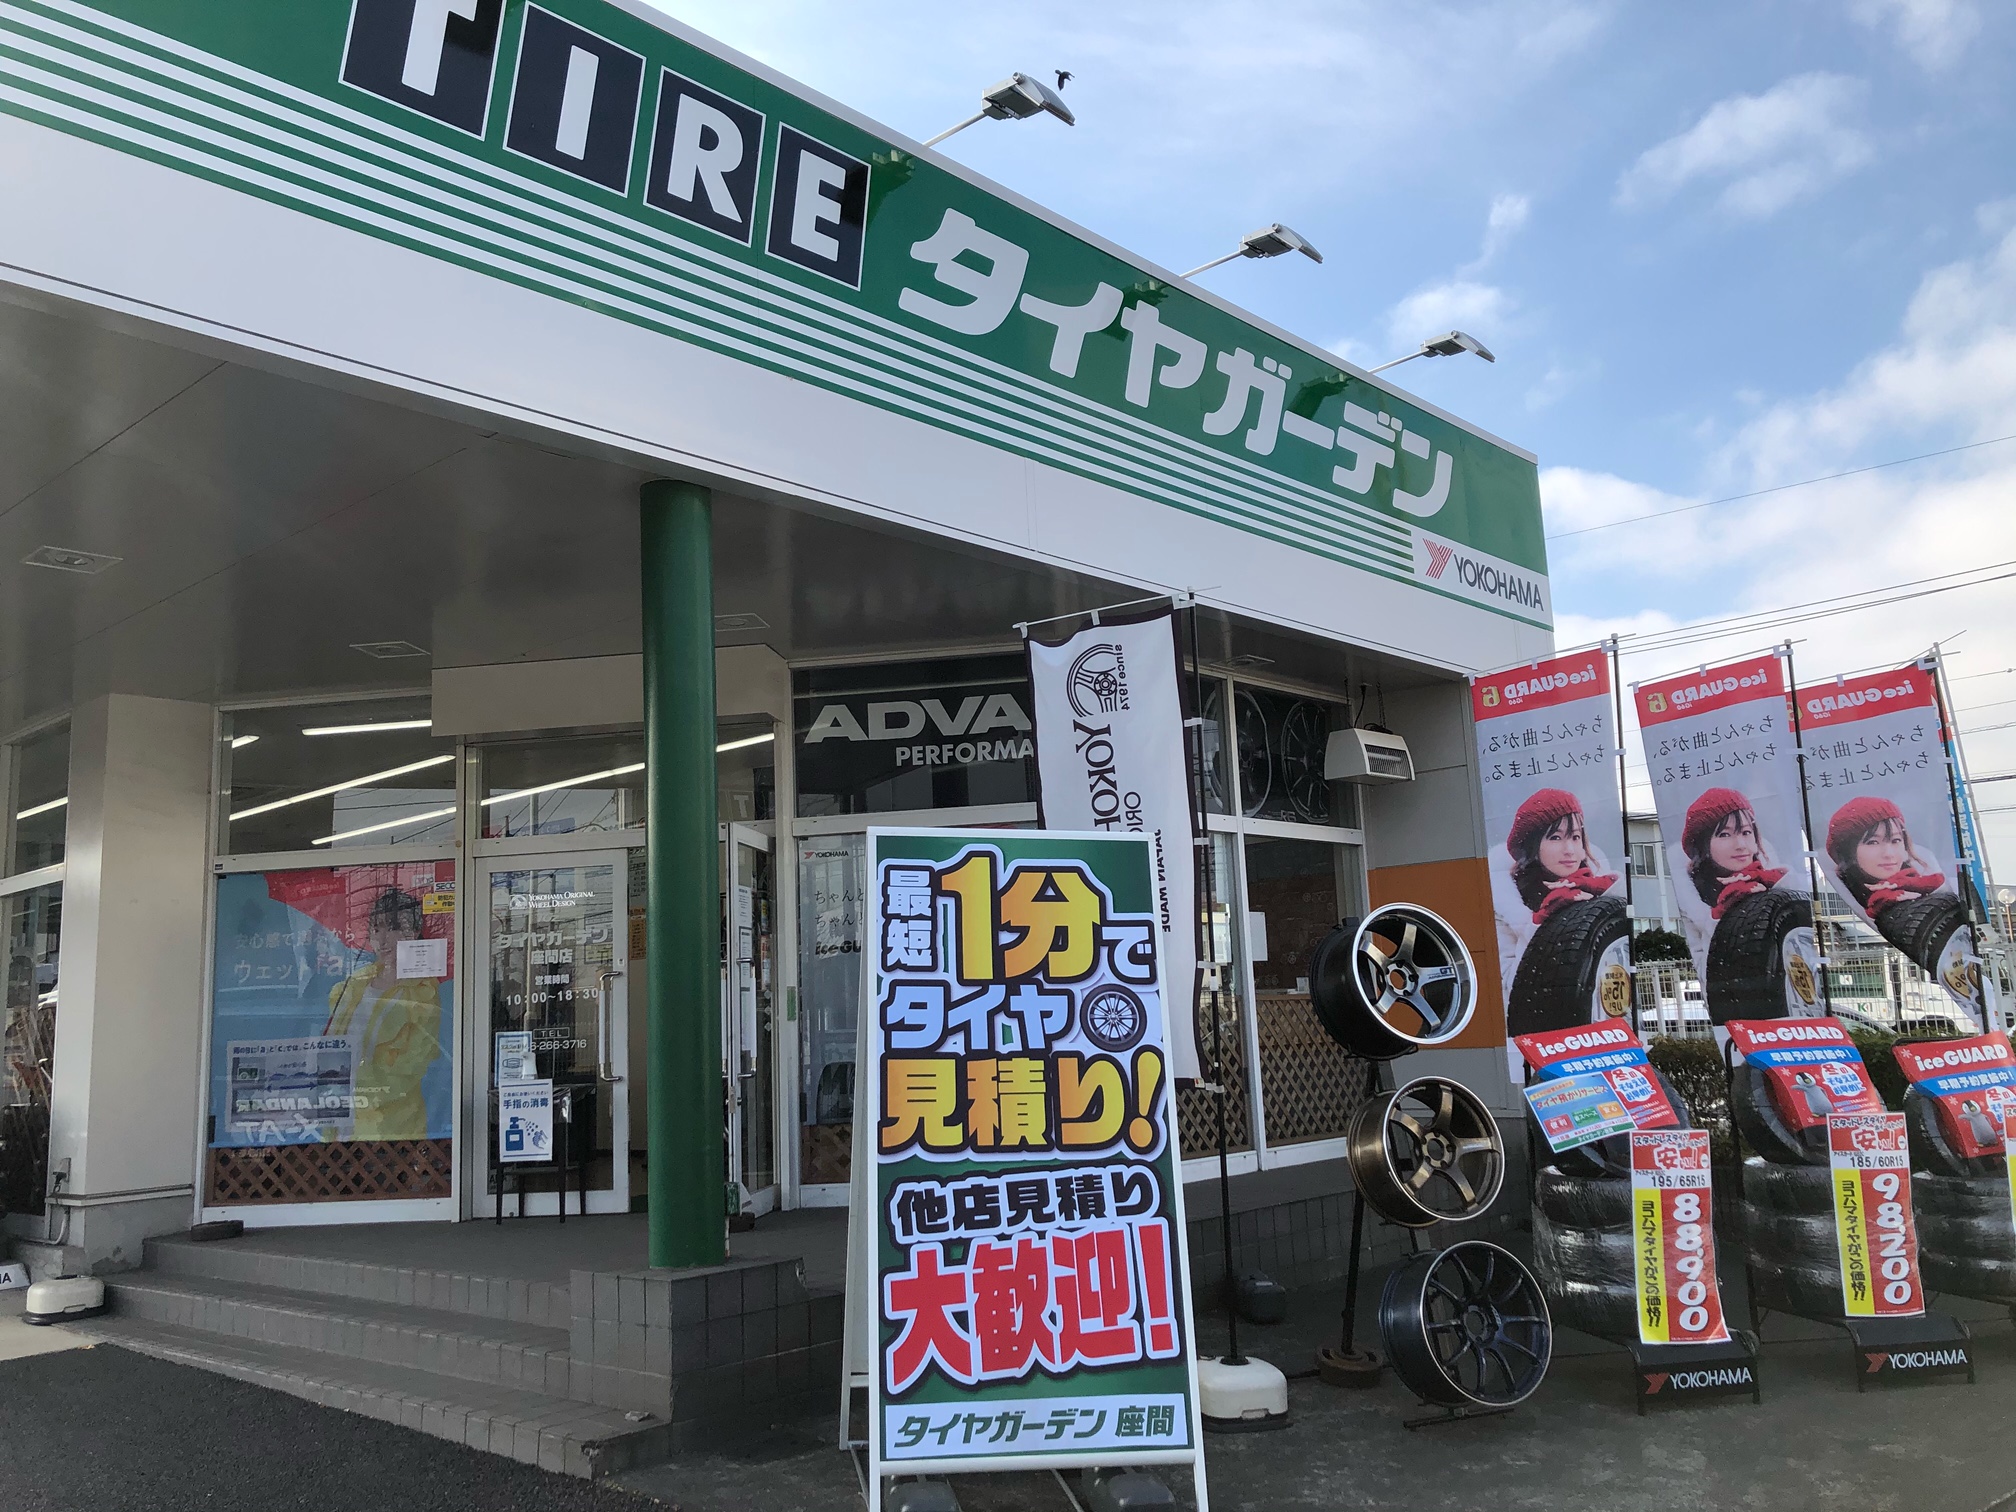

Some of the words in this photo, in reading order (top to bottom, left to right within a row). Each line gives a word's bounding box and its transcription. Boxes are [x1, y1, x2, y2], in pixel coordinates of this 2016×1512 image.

[401, 0, 847, 262] TIRE
[898, 208, 1454, 517] タイヤガーデン
[1454, 554, 1544, 611] YOKOHAMA
[804, 693, 1031, 744] ADVA
[896, 737, 1034, 767] PERFORMA
[815, 850, 849, 858] YOKOHAMA
[814, 888, 864, 905] ちゃんと
[886, 869, 934, 968] 最短
[531, 948, 573, 965] 座間店
[815, 940, 862, 956] iceGU
[886, 984, 1069, 1050] タイヤ
[531, 1039, 587, 1051] 6-266-3716
[541, 1030, 563, 1038] TEL
[1536, 1029, 1630, 1057] iceGUARD
[1747, 1026, 1844, 1044] iceGUARD
[1915, 1044, 2008, 1072] iceGUARD
[1850, 1156, 1904, 1168] 185/60R15
[1651, 1175, 1706, 1188] 195/65R15
[896, 1170, 1154, 1237] 他店見積り
[890, 1223, 1175, 1388] 大歓迎!
[1889, 1348, 1968, 1370] YOKOHAMA
[1670, 1367, 1753, 1390] YOKOHAMA
[894, 1409, 1106, 1449] タイヤガーデン
[1115, 1405, 1176, 1438] 座間
